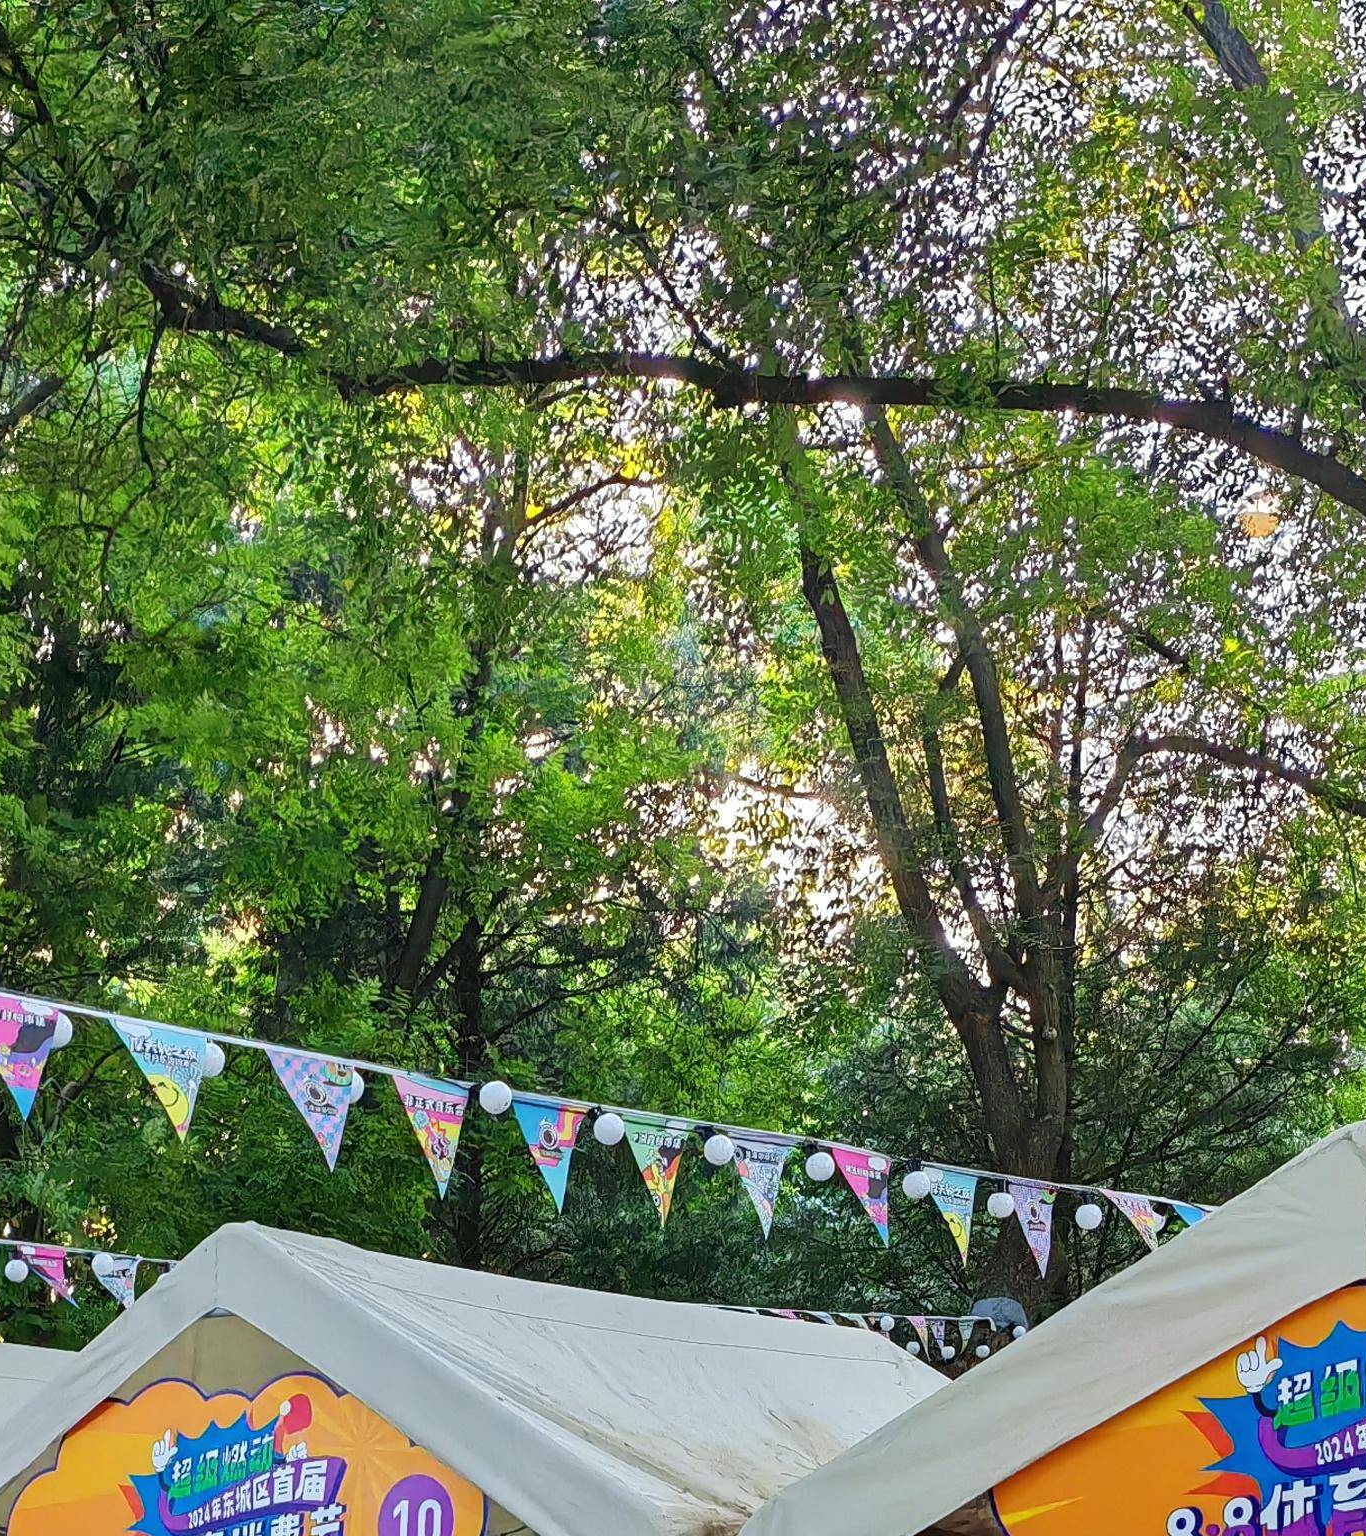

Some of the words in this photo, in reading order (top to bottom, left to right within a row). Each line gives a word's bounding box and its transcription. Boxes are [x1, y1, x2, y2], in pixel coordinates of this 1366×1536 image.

[171, 1433, 277, 1497] 超级燃动
[187, 1461, 329, 1530] 2024年东城区首届
